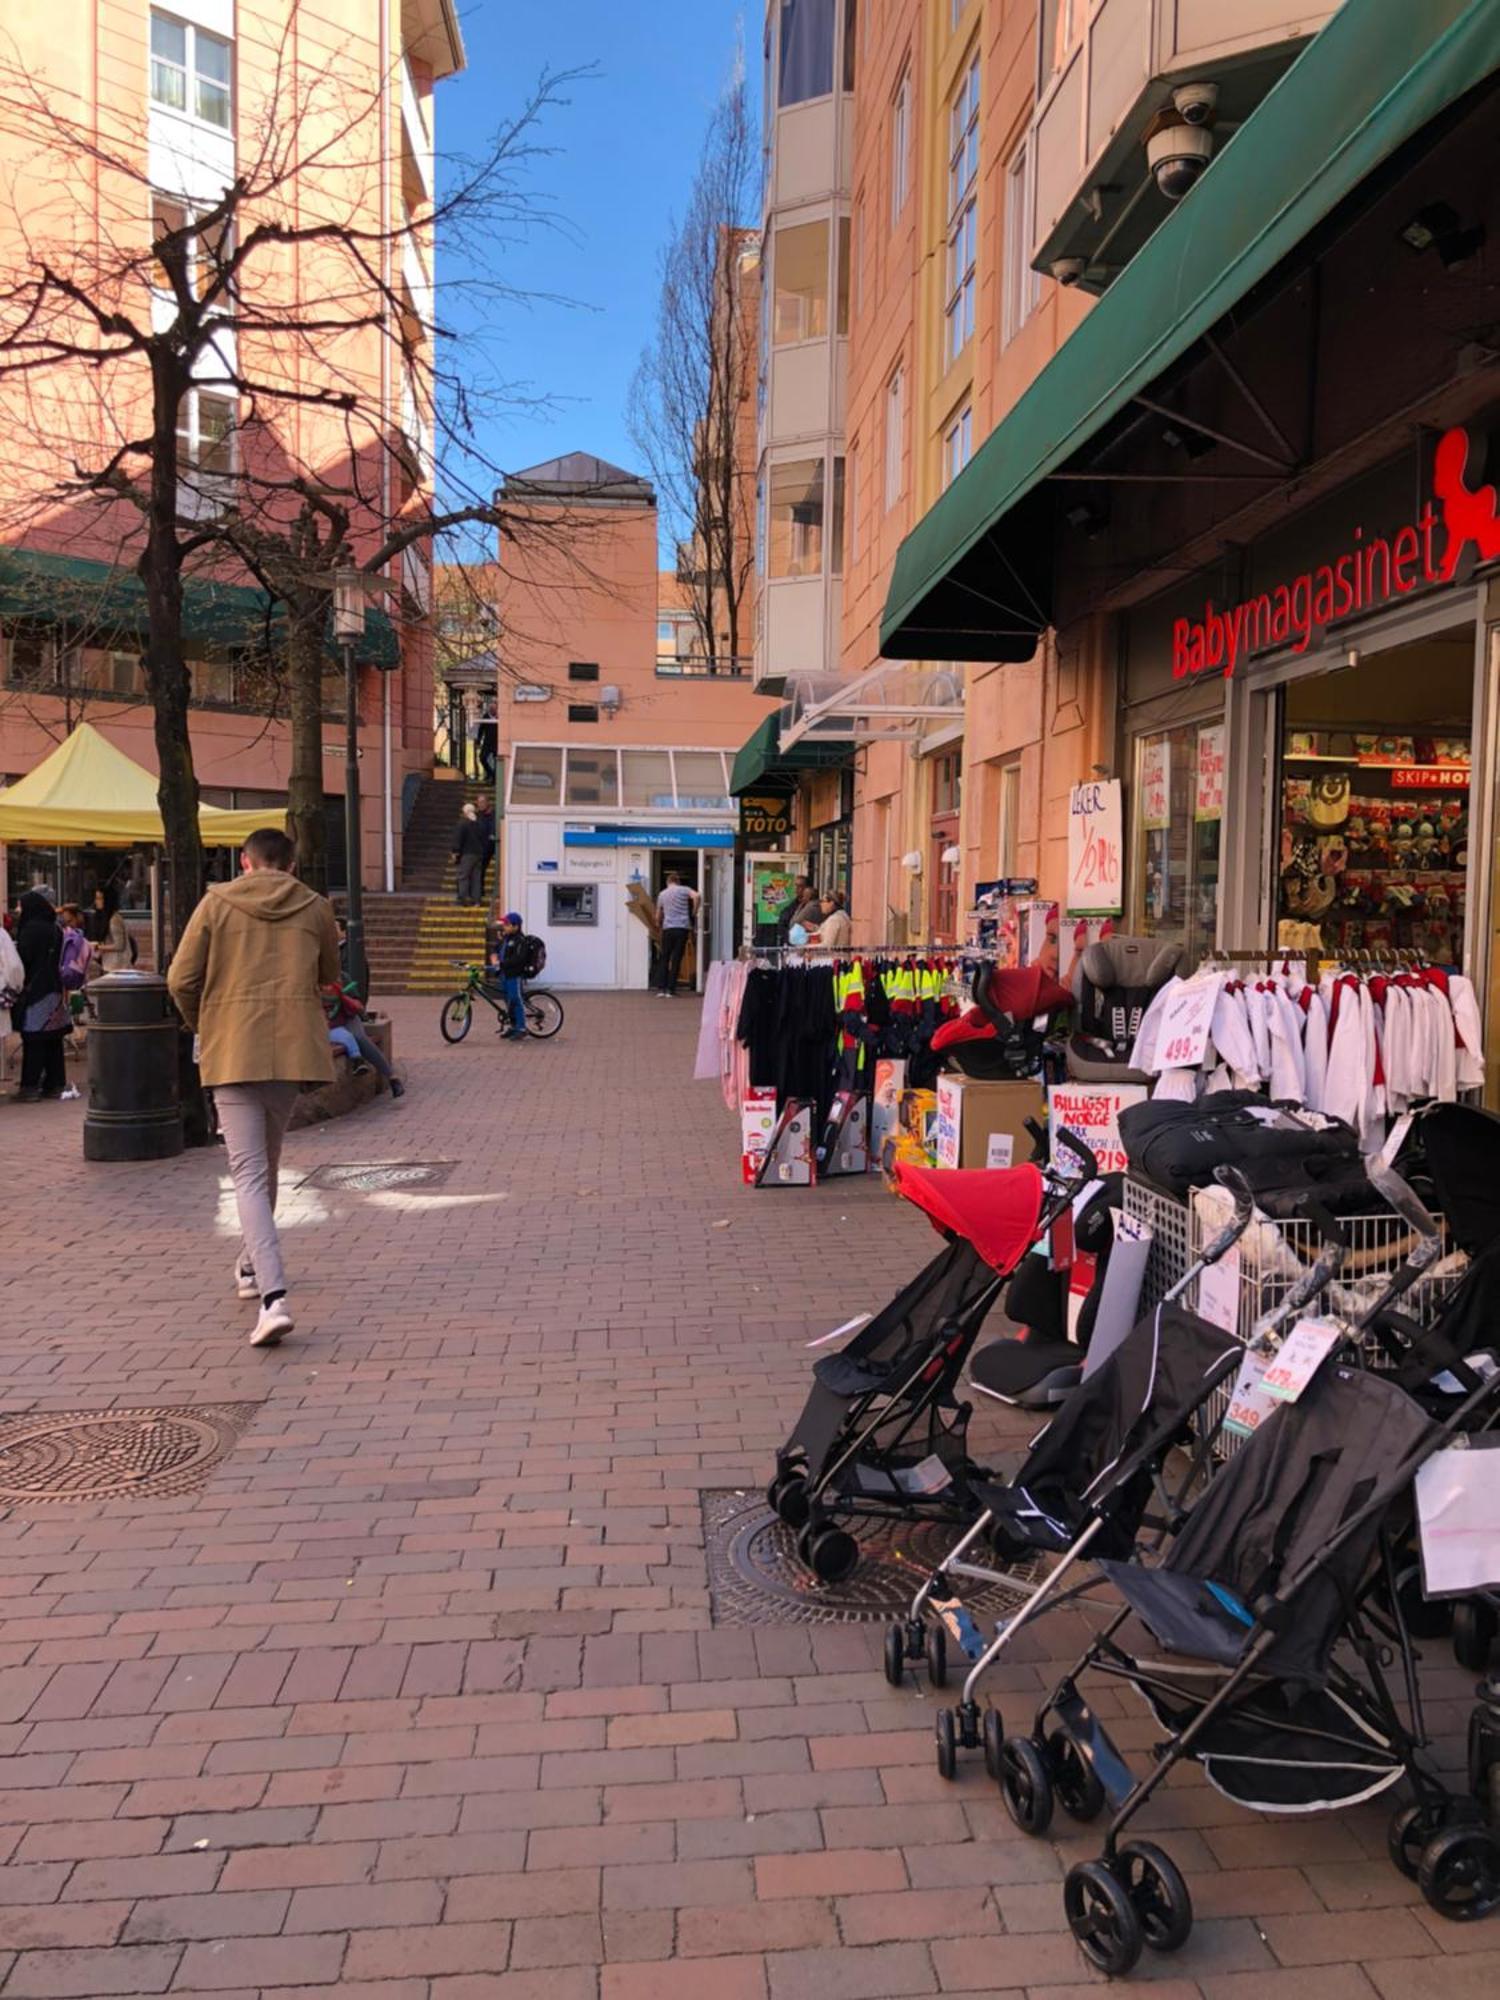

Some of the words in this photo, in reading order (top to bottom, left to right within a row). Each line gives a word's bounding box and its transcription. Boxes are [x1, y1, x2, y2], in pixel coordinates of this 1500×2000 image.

[1172, 500, 1438, 681] Babymagasinet
[744, 818, 787, 832] TOTO
[1053, 1094, 1111, 1112] BILLIGST
[1063, 1111, 1111, 1126] NORGE
